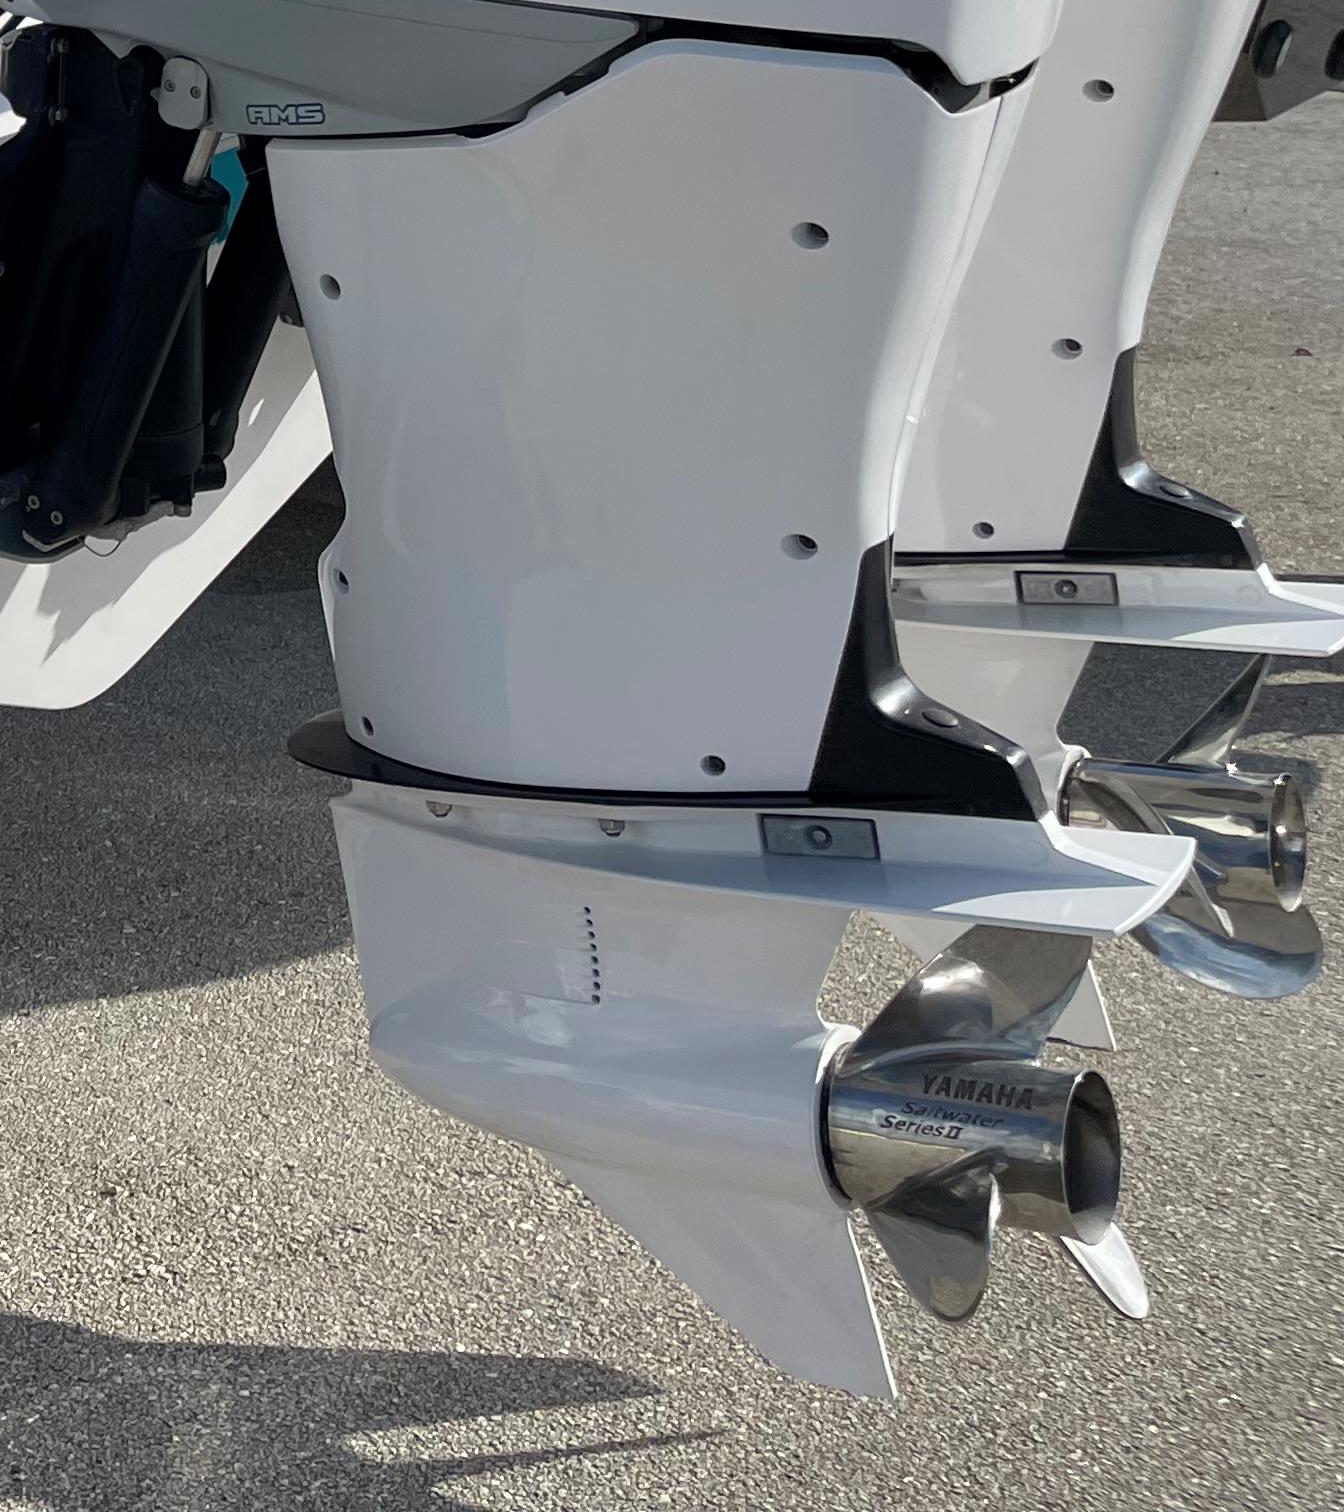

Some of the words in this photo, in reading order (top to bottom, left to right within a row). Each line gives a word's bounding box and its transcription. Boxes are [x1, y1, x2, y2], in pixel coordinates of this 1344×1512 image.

[245, 102, 326, 126] AMS
[922, 1072, 1034, 1110] YAMAHA
[900, 1100, 1006, 1128] Saltwater
